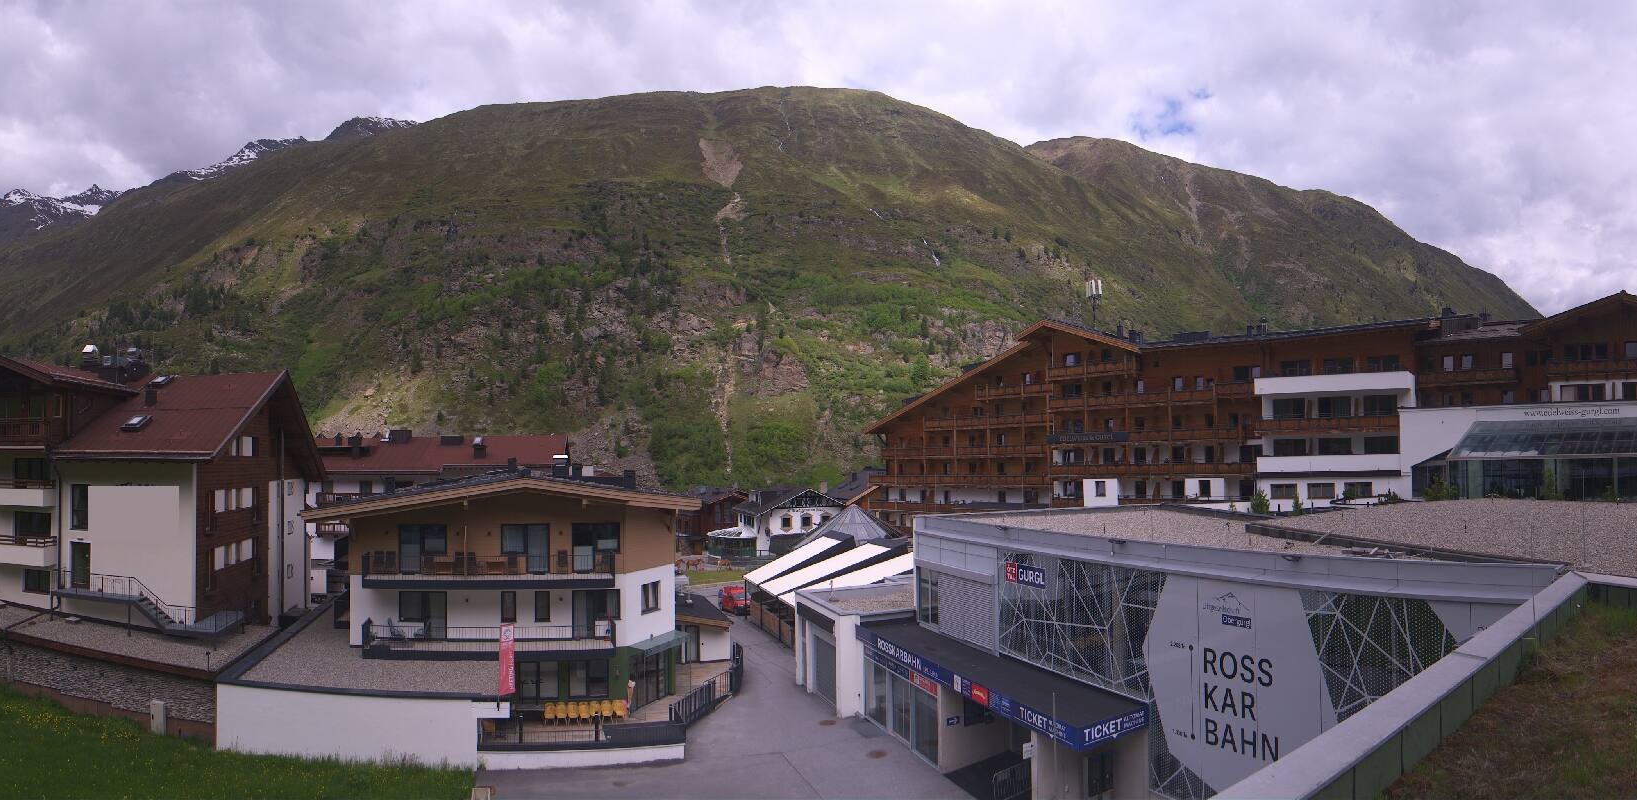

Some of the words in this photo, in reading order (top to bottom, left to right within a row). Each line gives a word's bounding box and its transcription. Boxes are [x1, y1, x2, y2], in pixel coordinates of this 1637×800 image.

[1523, 407, 1620, 417] www.edelweiss-gurgl.com
[1018, 568, 1045, 585] GURGL
[877, 638, 922, 670] ROSSKARBAHN
[1203, 647, 1273, 687] ROSS
[1204, 682, 1256, 721] KAR
[1019, 706, 1048, 729] TICKET
[1084, 717, 1123, 742] TICKET
[1205, 717, 1279, 762] BAHN
